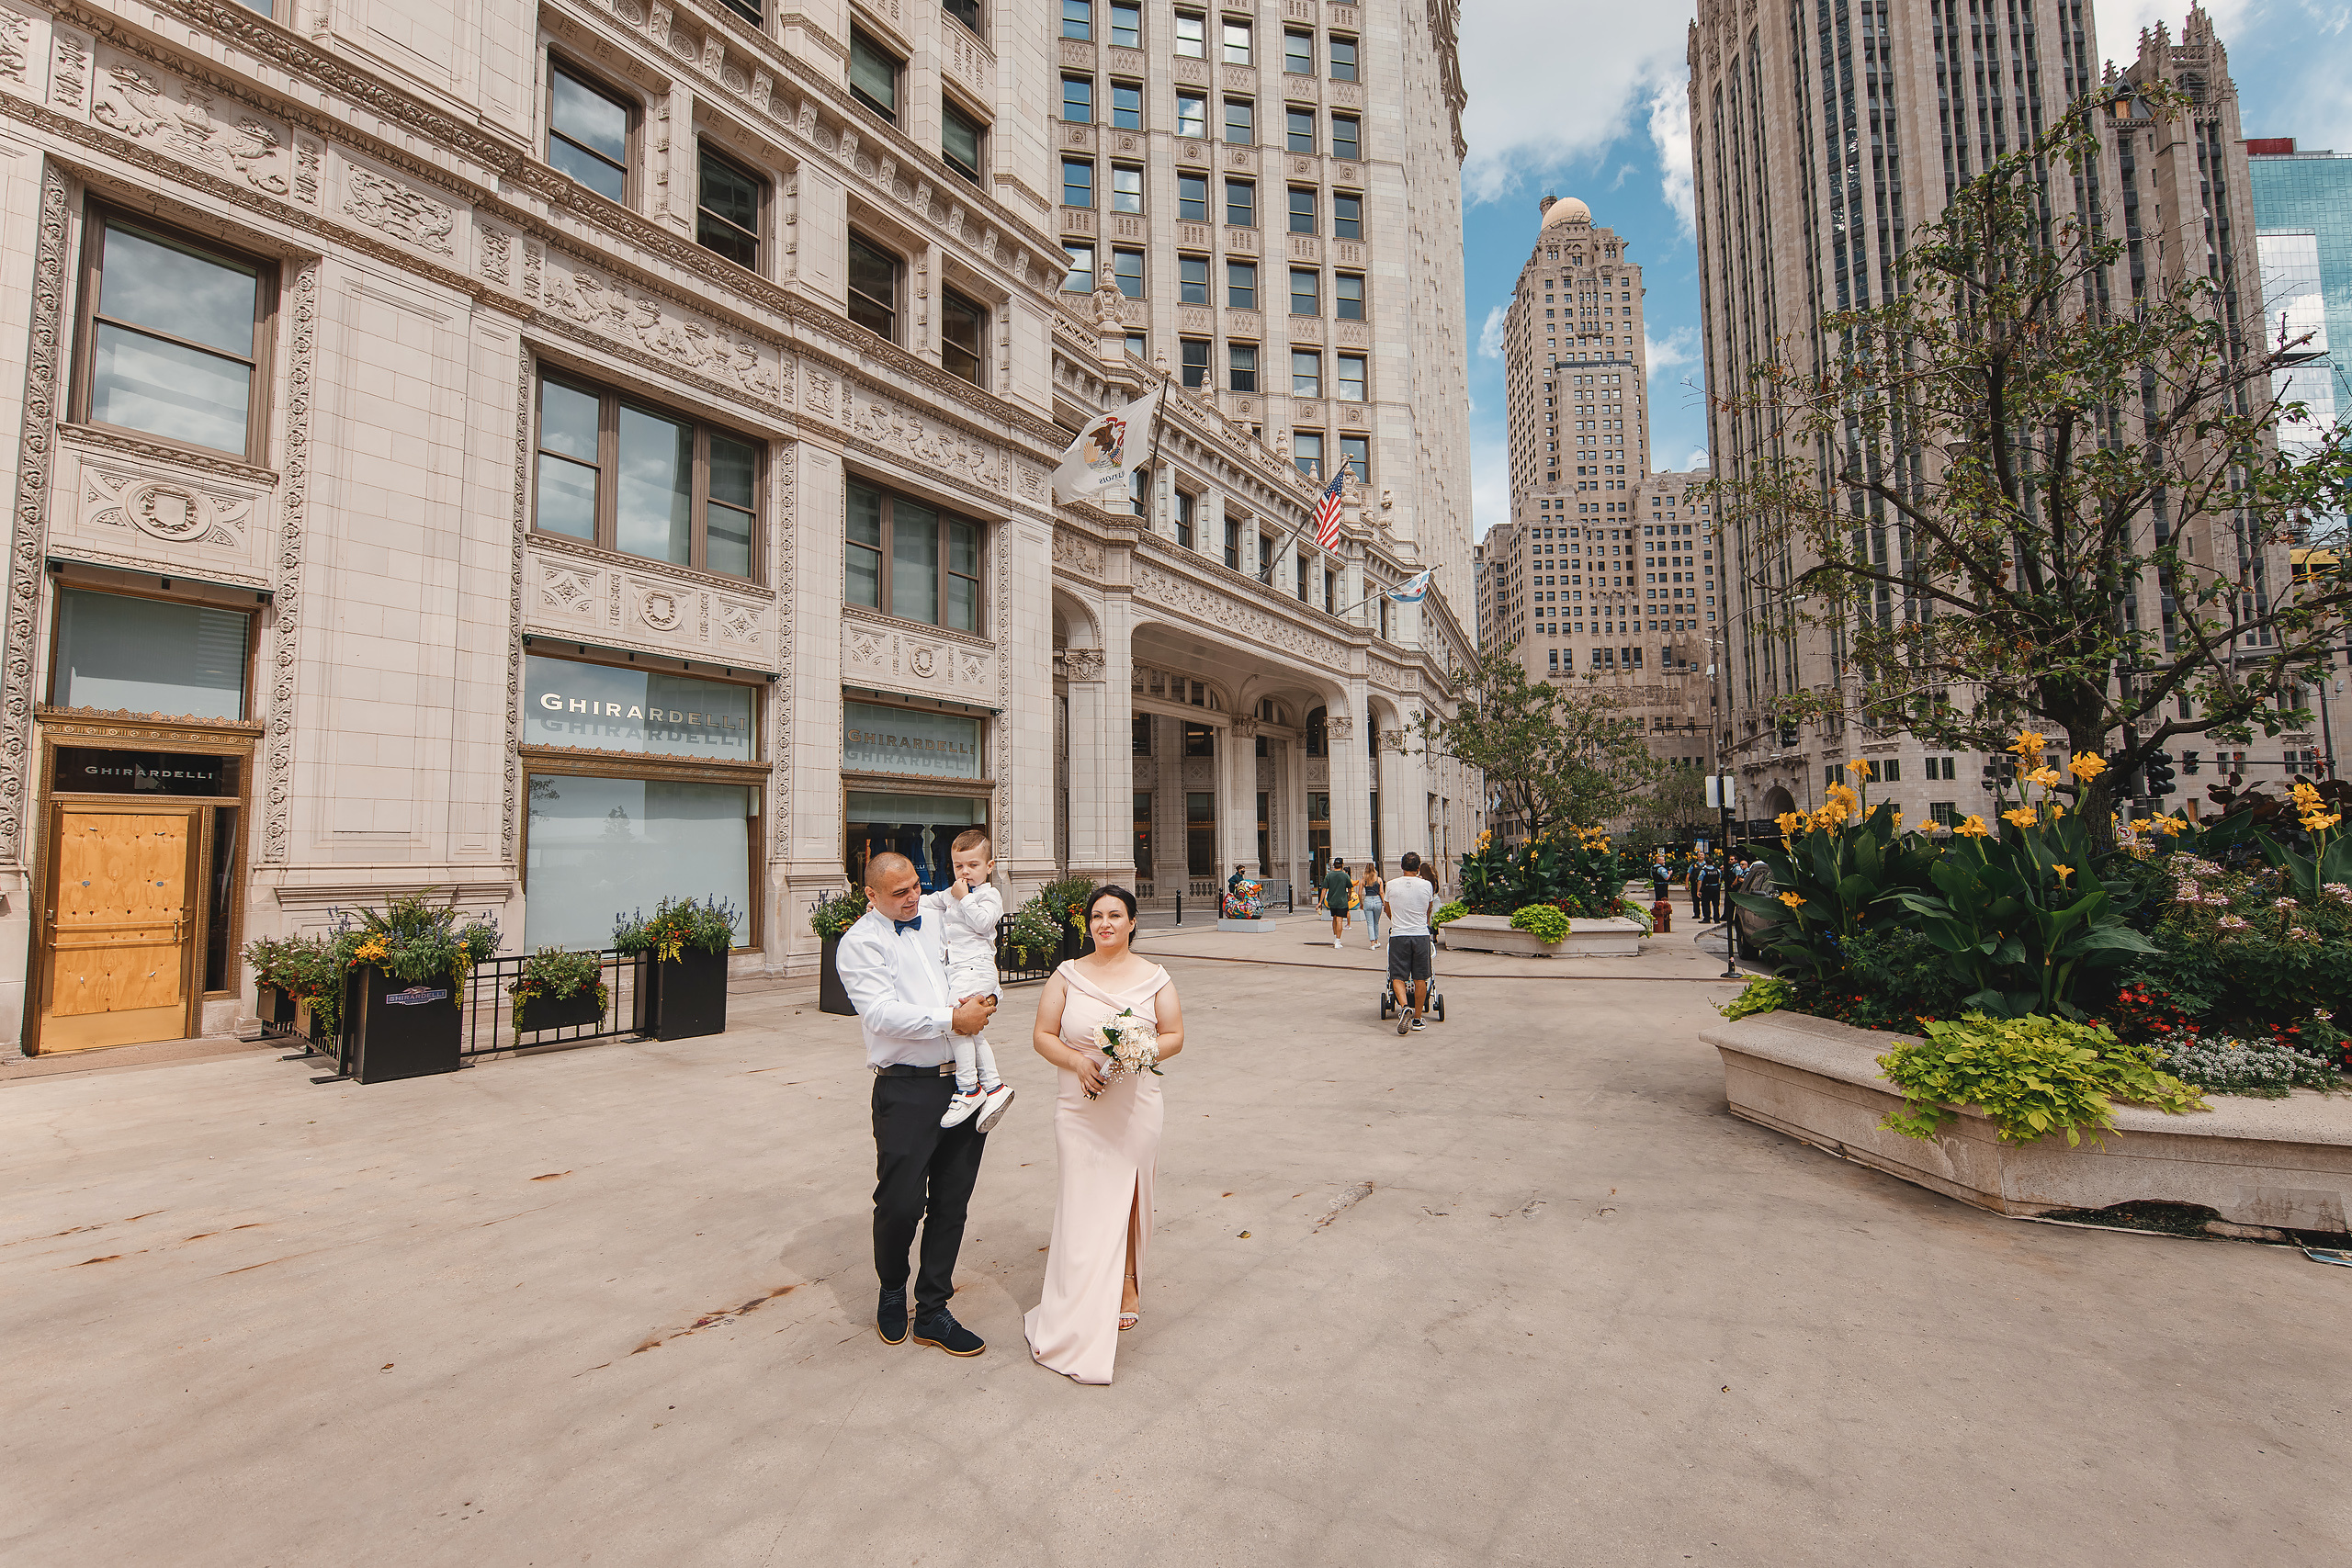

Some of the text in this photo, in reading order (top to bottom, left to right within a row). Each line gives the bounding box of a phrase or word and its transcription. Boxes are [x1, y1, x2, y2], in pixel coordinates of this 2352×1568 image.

[539, 693, 746, 731] GHIRARDELLI
[847, 728, 975, 755] GHIRARDELLI
[85, 766, 213, 780] GHIRARDELLI
[389, 992, 445, 1001] GHIRARDELLI
